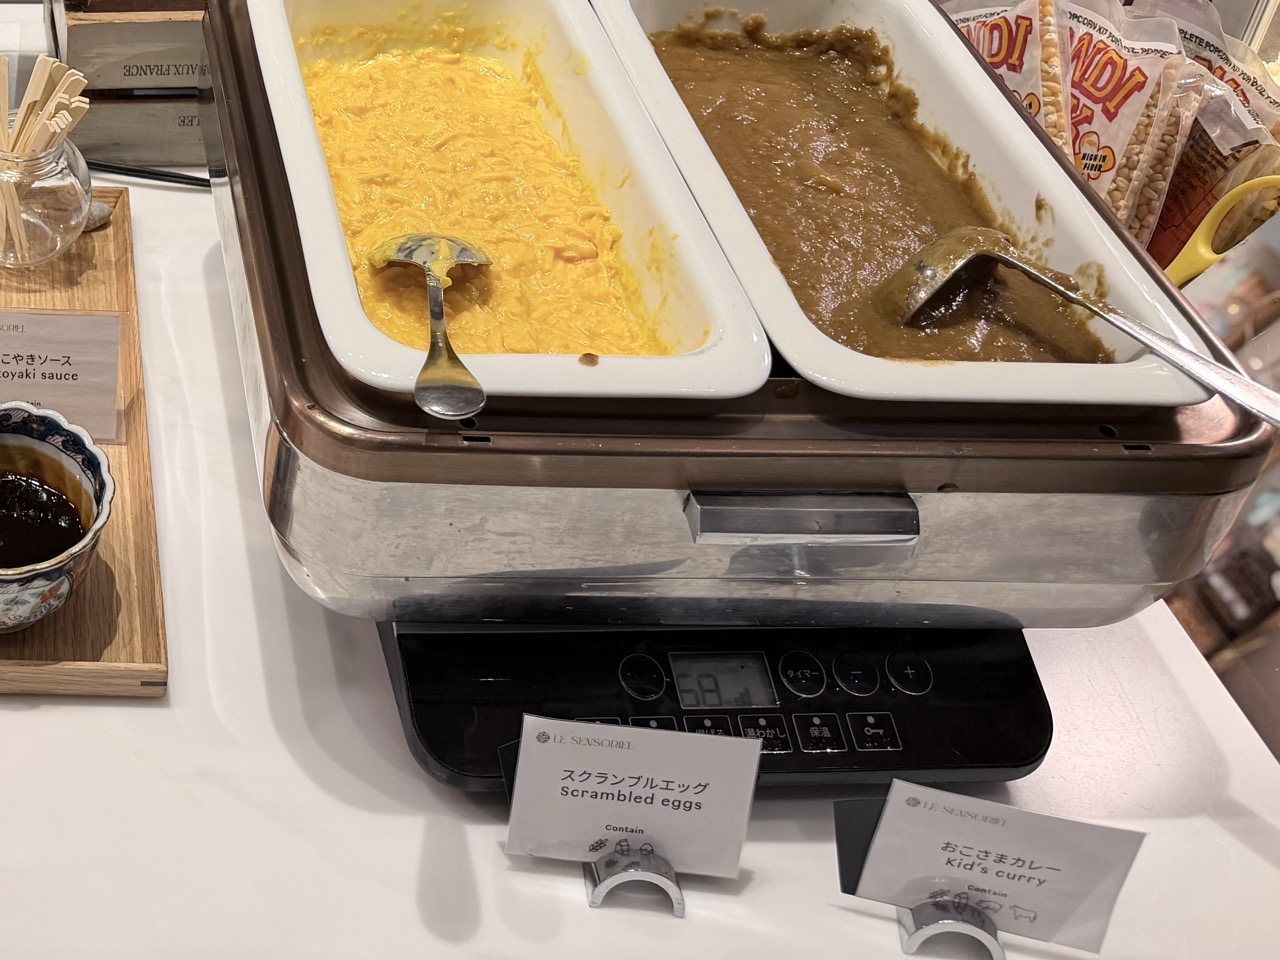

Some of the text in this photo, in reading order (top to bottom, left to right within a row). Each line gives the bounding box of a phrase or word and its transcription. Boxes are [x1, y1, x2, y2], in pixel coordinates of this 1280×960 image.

[1068, 27, 1149, 123] NDI
[41, 372, 79, 381] sauce
[787, 669, 820, 678] タイマー
[809, 726, 832, 738] 保温
[571, 736, 635, 751] SENSORIEL
[560, 768, 710, 796] スクランブルエッグ
[560, 785, 703, 812] Scrambled eggs
[605, 824, 645, 835] Contain
[940, 840, 1062, 873] おこさまカレー
[995, 868, 1048, 887] curry
[966, 884, 1008, 898] Contain
